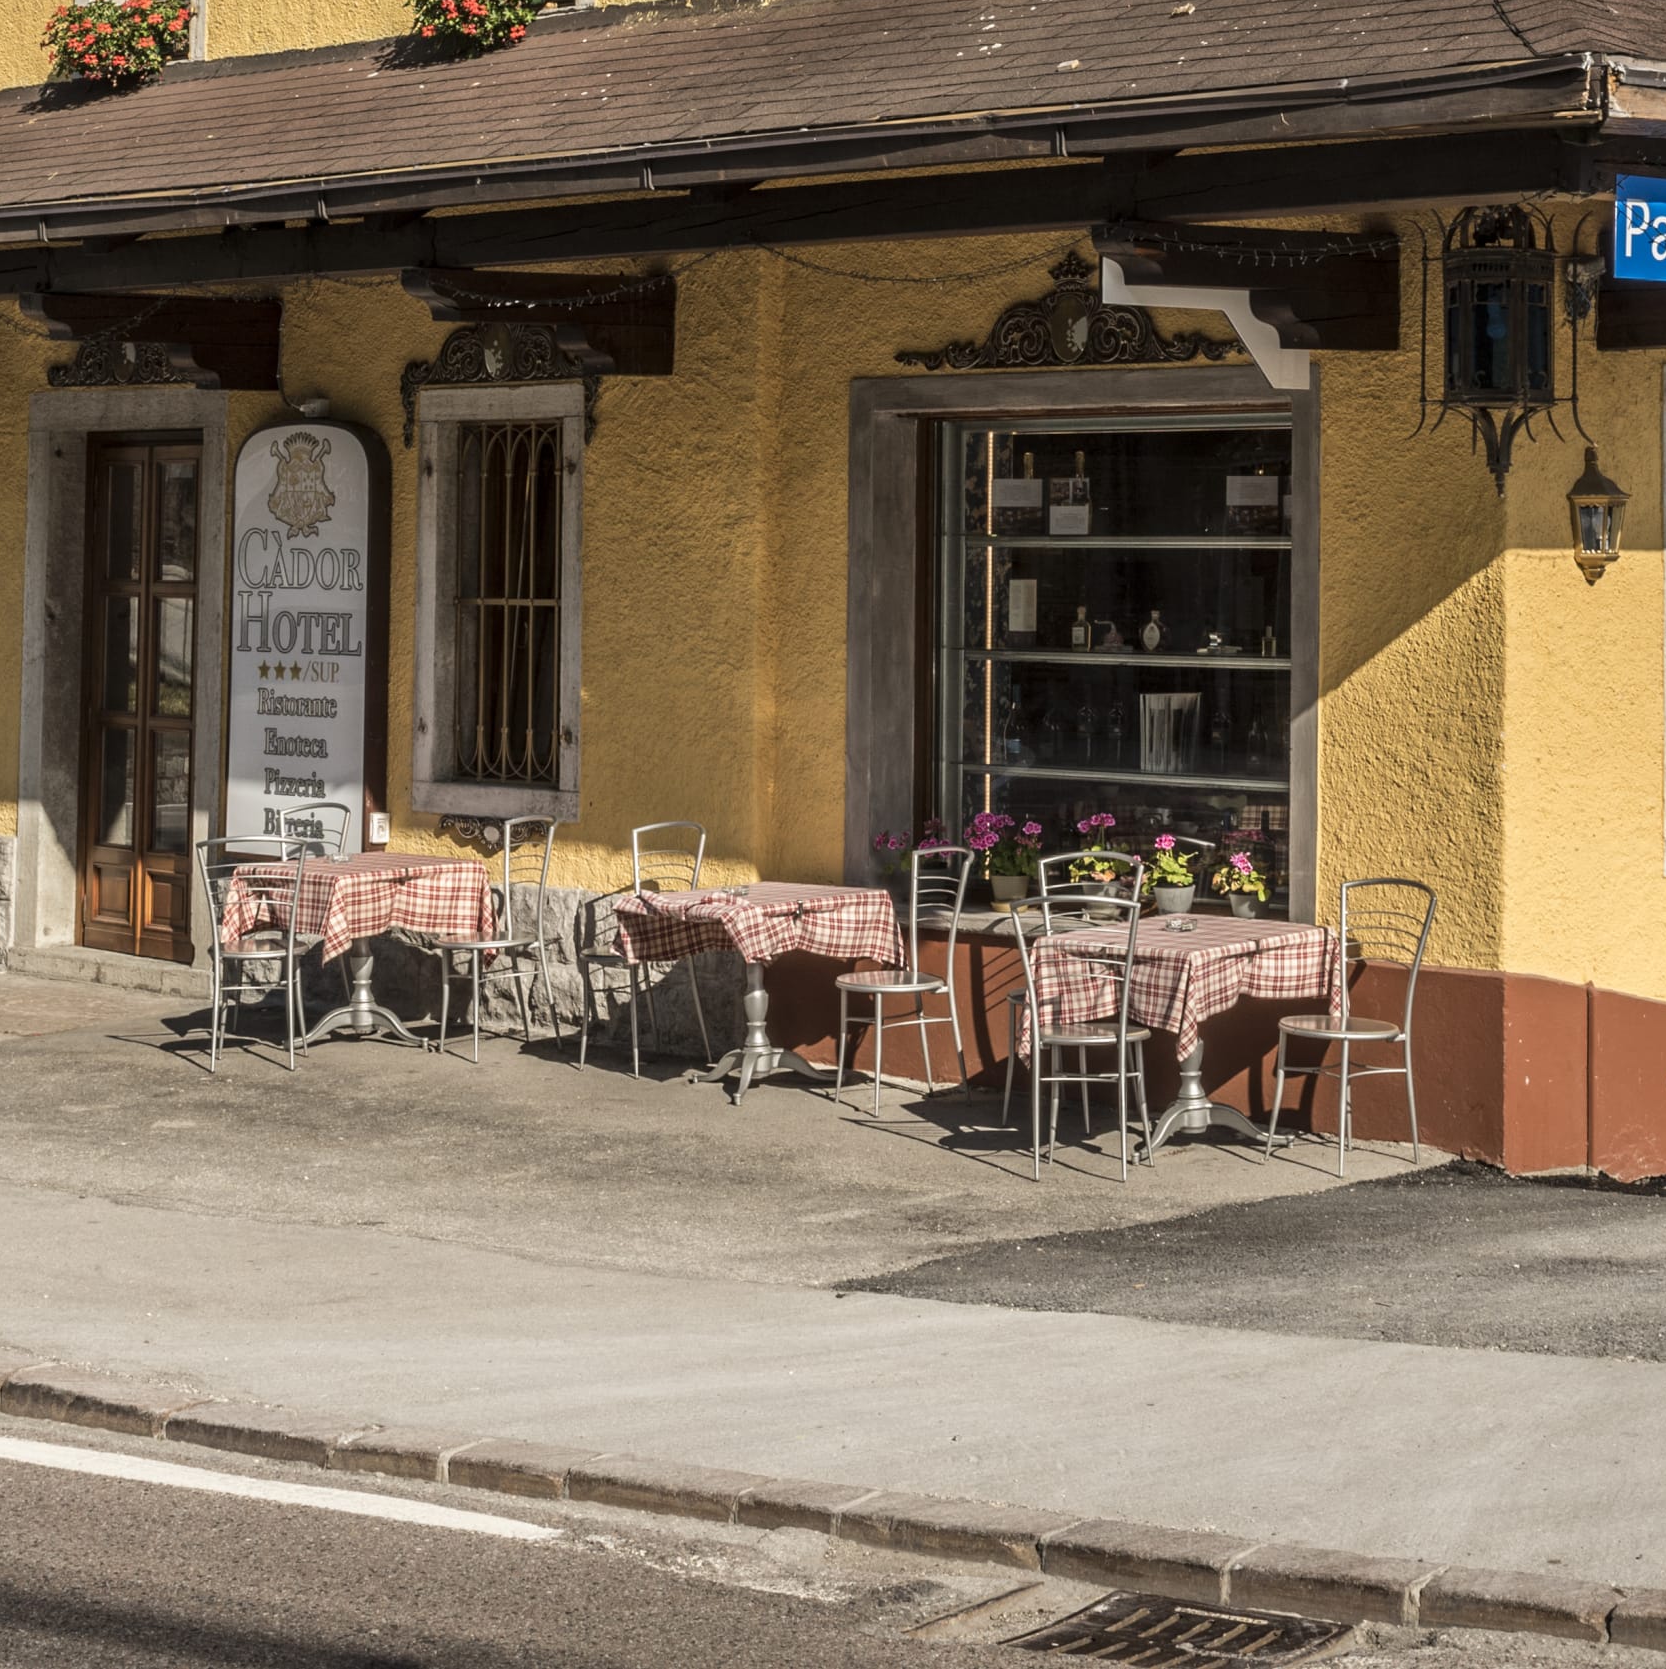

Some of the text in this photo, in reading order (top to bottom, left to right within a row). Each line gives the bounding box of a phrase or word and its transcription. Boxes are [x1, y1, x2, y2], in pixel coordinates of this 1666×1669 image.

[236, 590, 362, 657] HOTEL
[257, 687, 338, 719] Ristorante
[263, 727, 329, 759] Enoteca
[264, 767, 326, 799] Pizzeria
